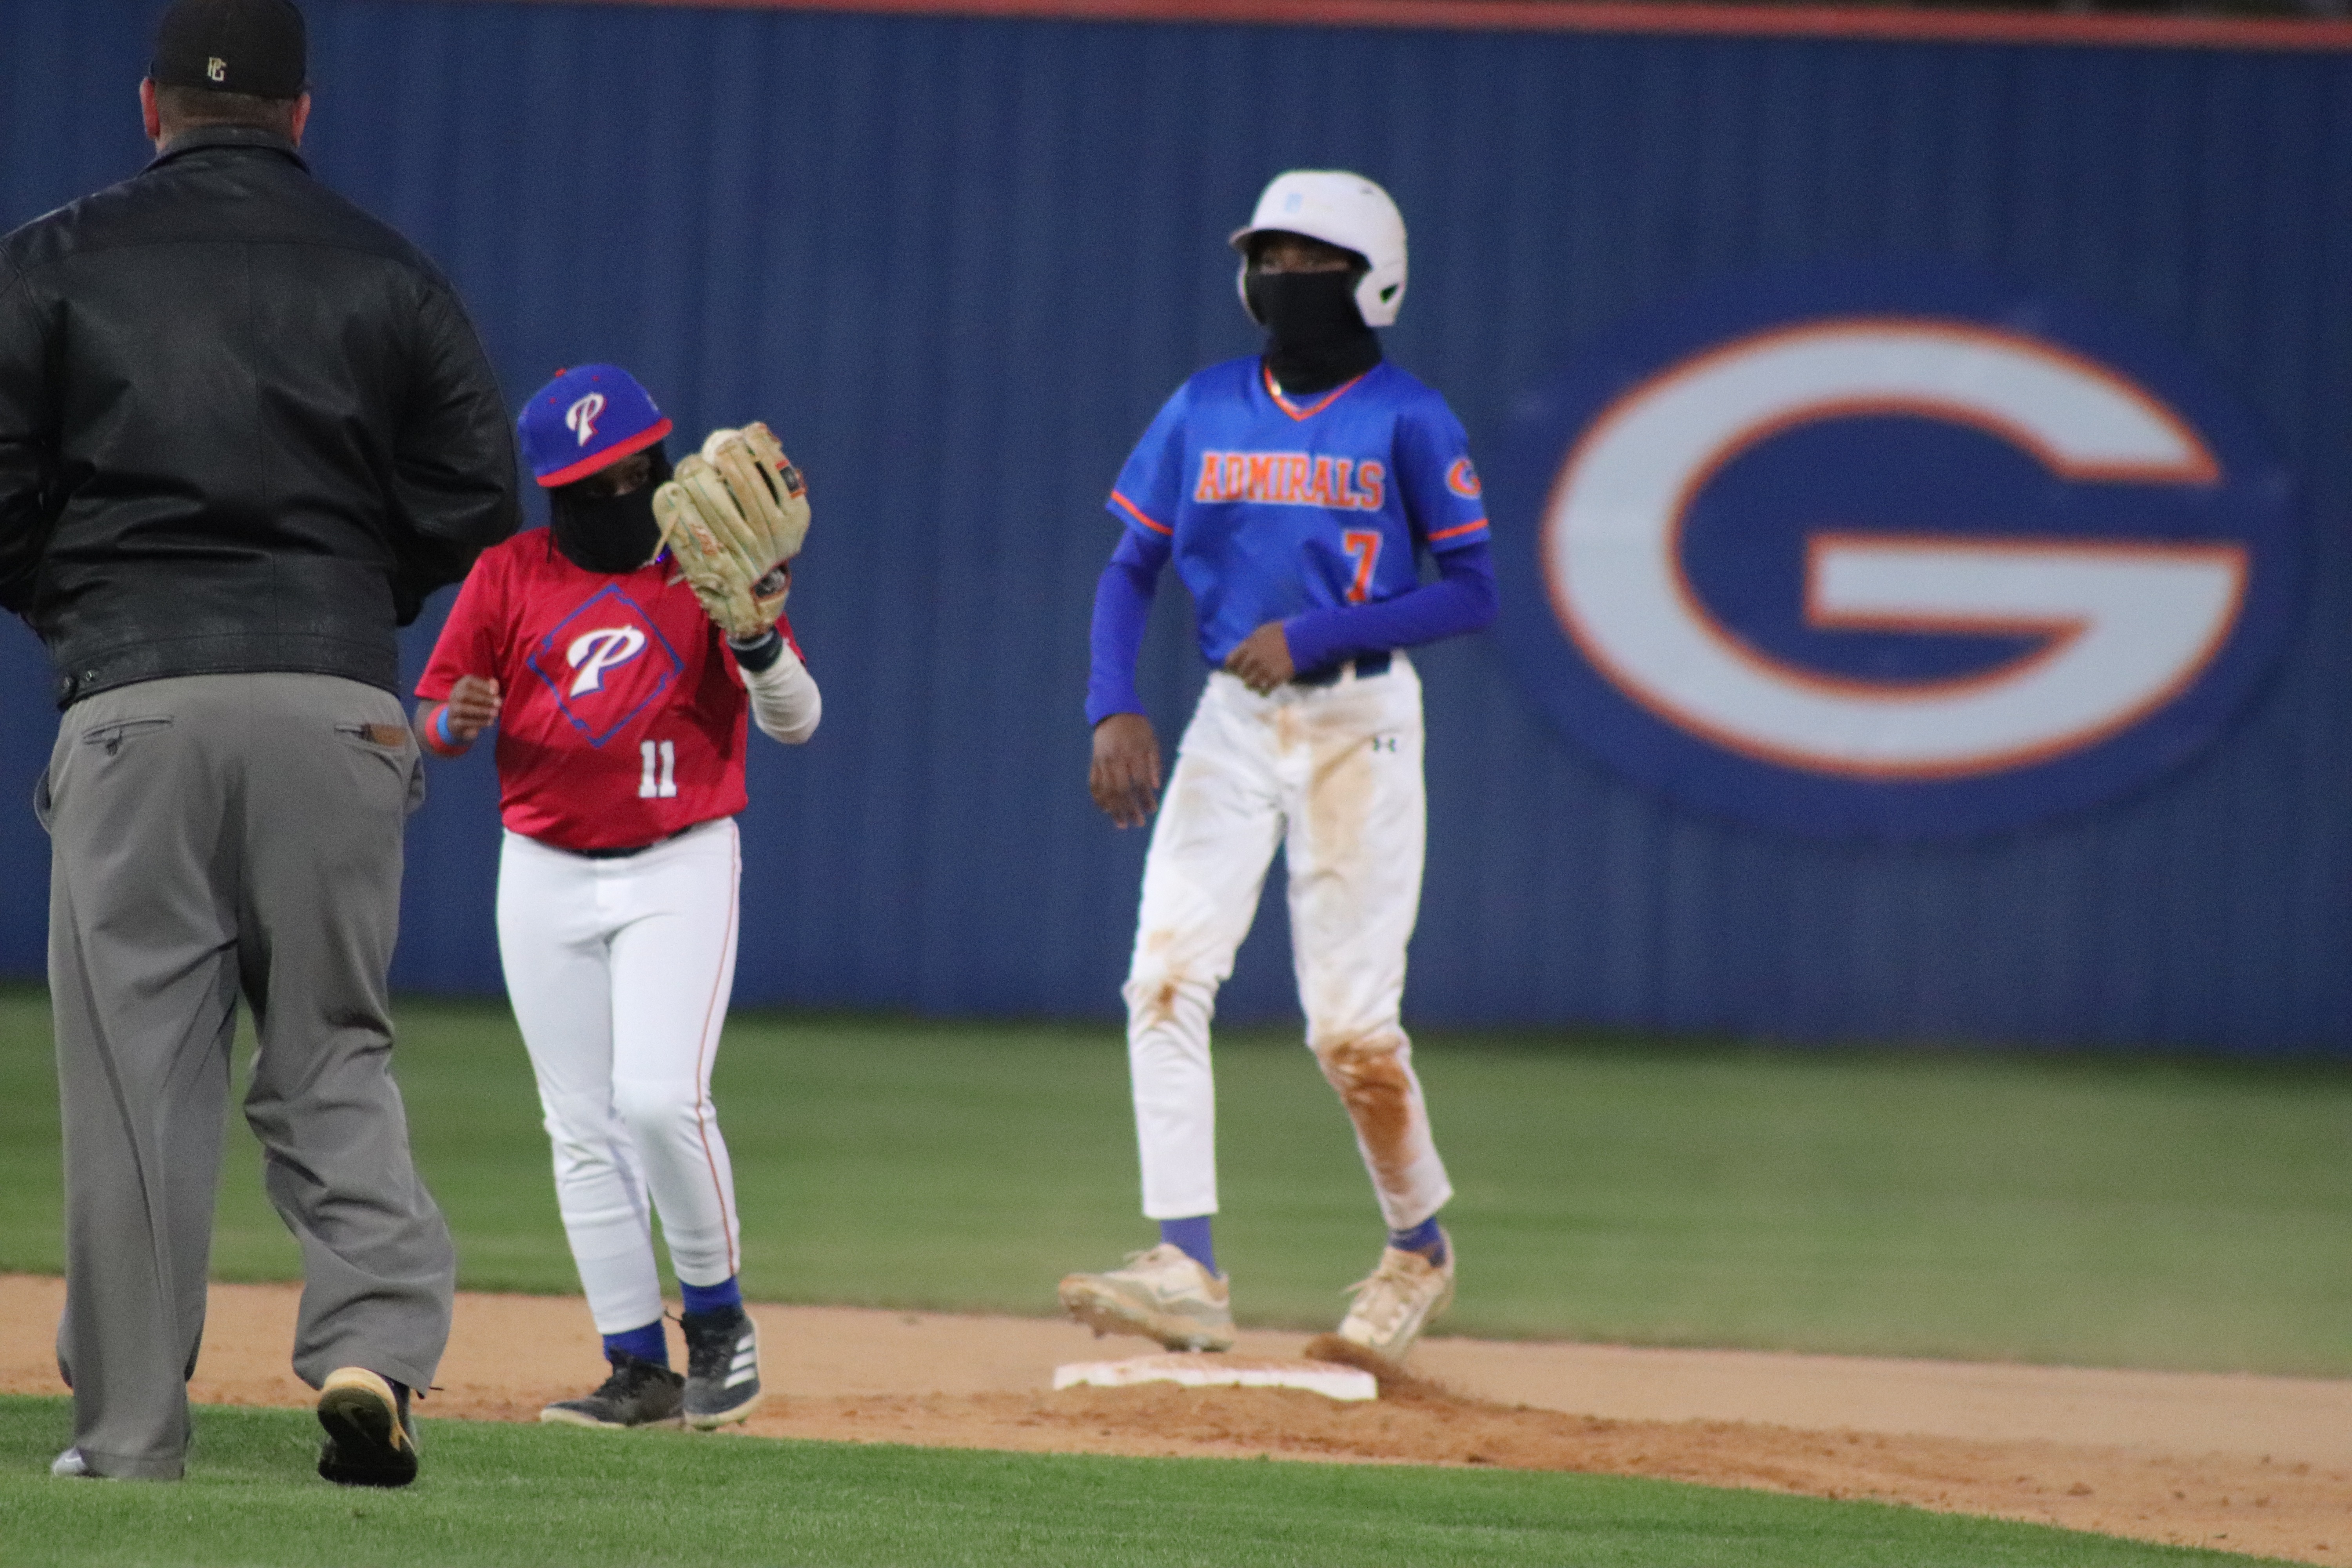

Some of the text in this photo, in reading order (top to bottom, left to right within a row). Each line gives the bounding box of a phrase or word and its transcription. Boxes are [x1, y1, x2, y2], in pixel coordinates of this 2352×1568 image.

[566, 392, 607, 447] P
[1194, 452, 1385, 510] ADMIRALS
[1343, 530, 1383, 603] 7
[1539, 315, 2249, 778] G
[566, 624, 648, 700] P
[639, 740, 677, 797] 11
